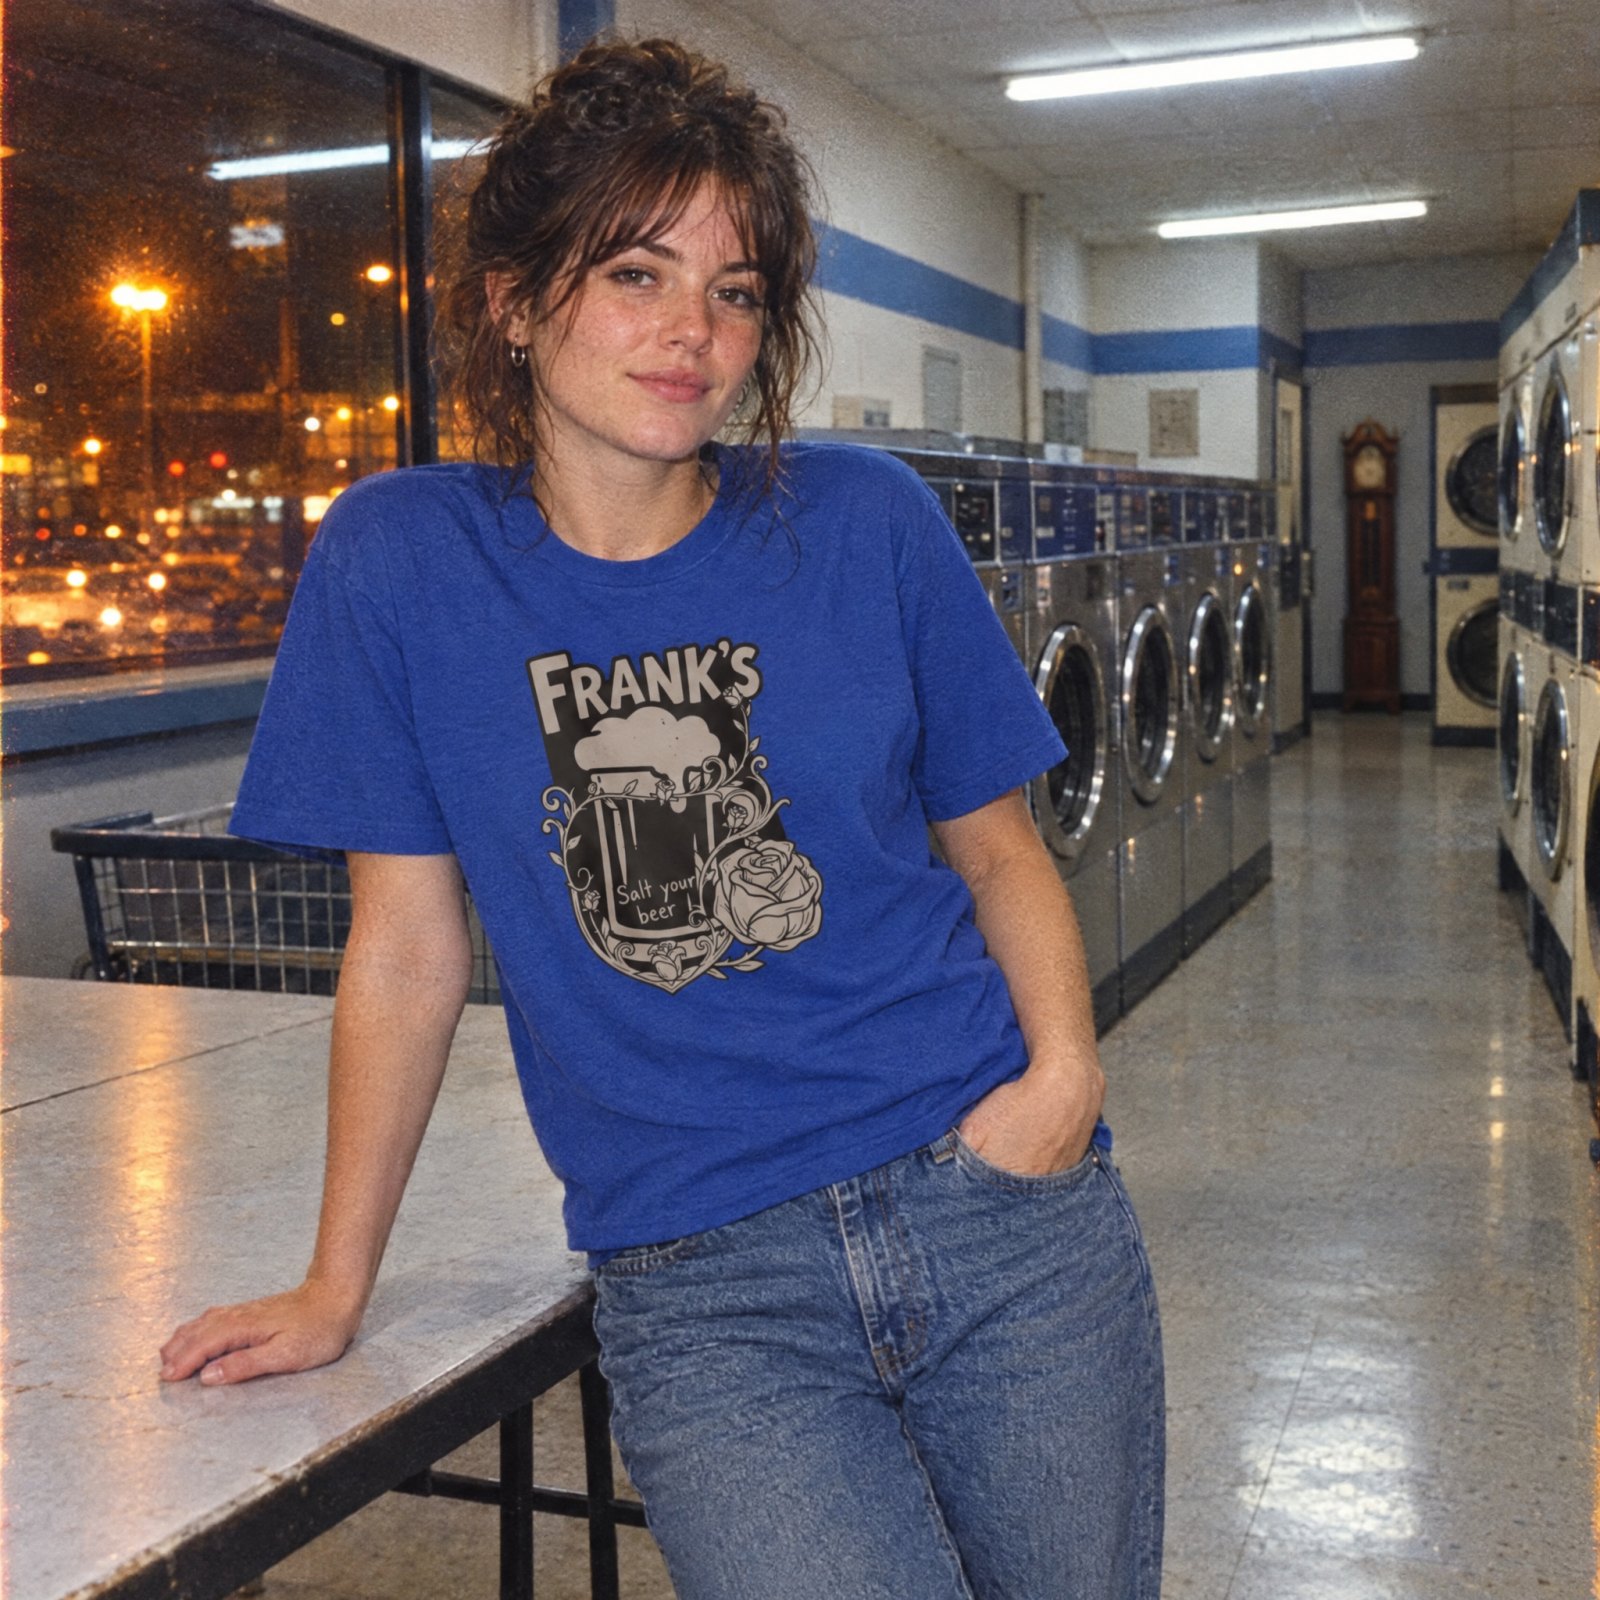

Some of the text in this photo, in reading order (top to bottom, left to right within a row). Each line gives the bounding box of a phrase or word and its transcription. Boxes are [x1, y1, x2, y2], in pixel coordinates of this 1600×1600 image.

[528, 639, 761, 735] FRANK'S
[616, 875, 696, 905] Salt your
[636, 903, 676, 925] beer
